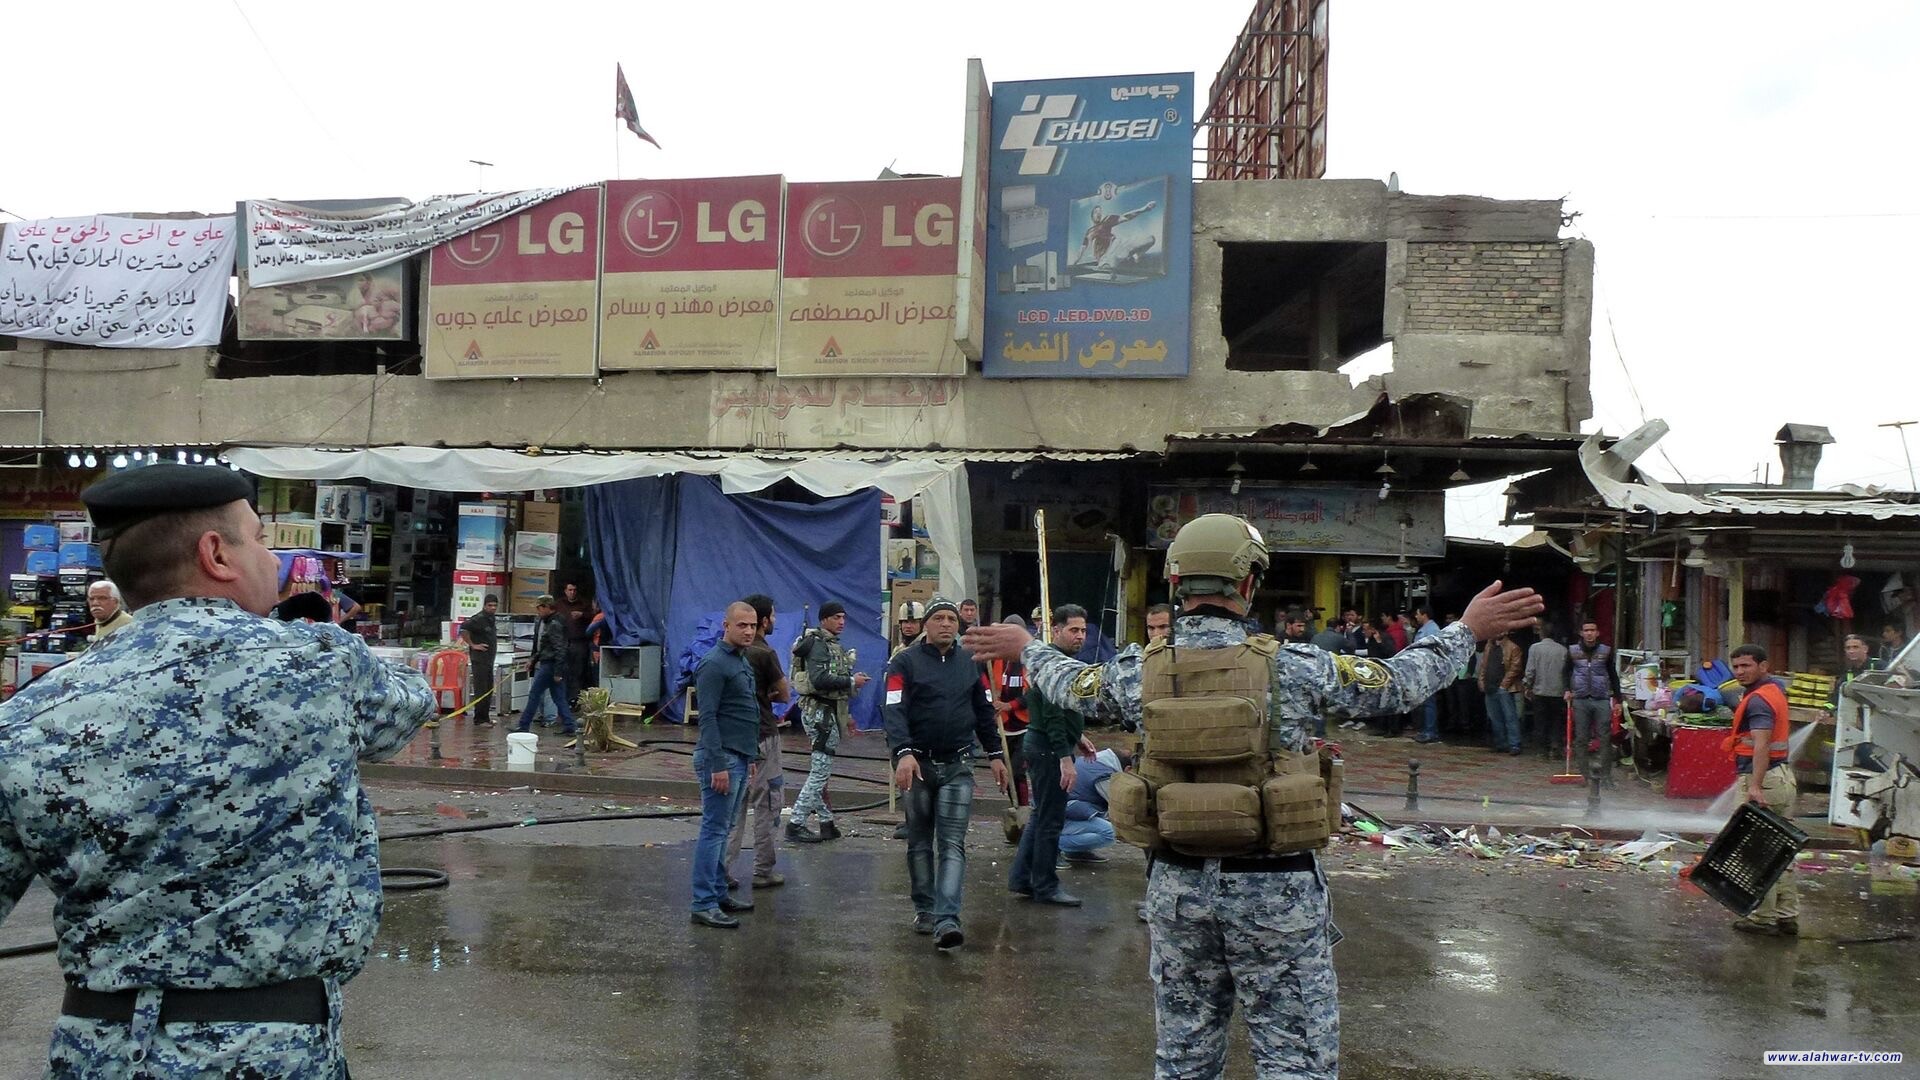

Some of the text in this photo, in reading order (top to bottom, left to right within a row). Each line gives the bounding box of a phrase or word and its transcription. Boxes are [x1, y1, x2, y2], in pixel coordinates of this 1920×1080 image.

[1051, 117, 1160, 142] CHUSEI
[18, 216, 225, 246] علي مع الحق والحق مع علي
[253, 221, 284, 236] العبادي
[517, 211, 585, 255] LG
[695, 199, 767, 244] LG
[880, 203, 955, 248] LG
[44, 247, 70, 271] قبل
[72, 247, 123, 268] المحلات
[126, 254, 183, 271] مشترين
[187, 250, 218, 273] نحن
[135, 291, 158, 310] يتم
[167, 289, 196, 307] لماذا
[606, 296, 774, 321] معرض مهند و بسام
[71, 312, 95, 336] الحق
[482, 305, 523, 330] علي
[529, 304, 588, 328] معرض
[789, 301, 956, 325] معرض المصطفى
[1017, 309, 1050, 324] LCD
[54, 316, 68, 335] مع
[156, 316, 194, 339] قانون
[1002, 330, 1169, 369] معرض القمة
